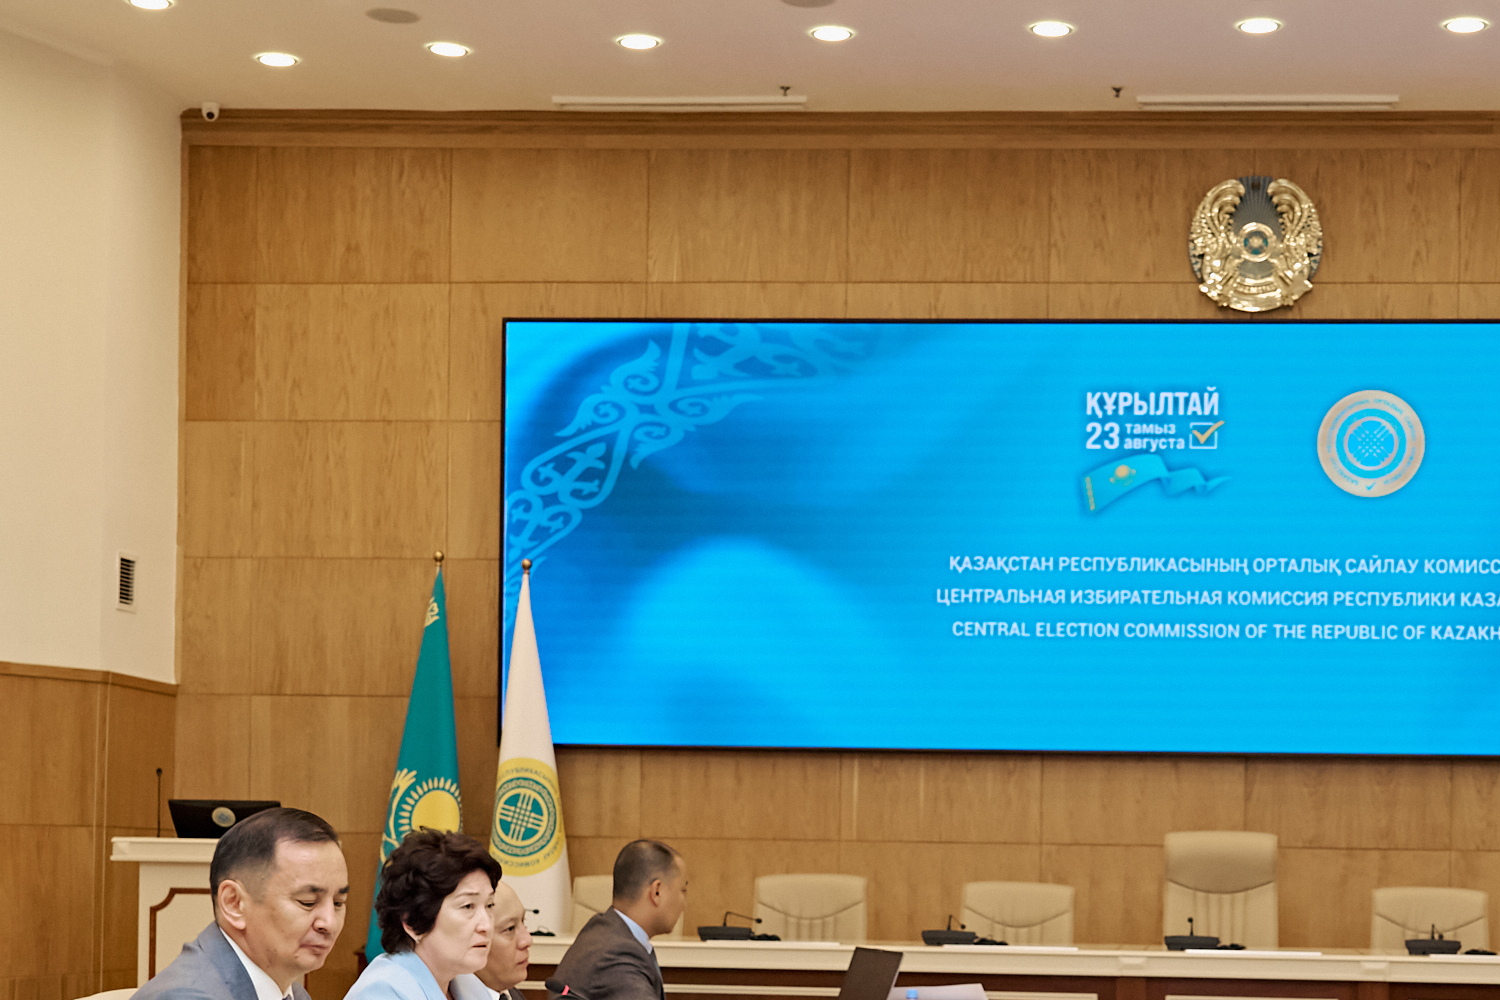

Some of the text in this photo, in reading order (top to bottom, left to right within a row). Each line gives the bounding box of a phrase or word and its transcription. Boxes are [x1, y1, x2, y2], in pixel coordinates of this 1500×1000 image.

[1086, 386, 1219, 419] ҚҰРЫЛТАЙ
[1085, 421, 1176, 450] 23 тамыз
[1123, 437, 1185, 453] августа
[949, 555, 1054, 574] ҚАЗАҚСТАН
[1058, 556, 1250, 576] РЕСПУБЛИКАСЫНЫҢ
[1252, 557, 1342, 576] ОРТАЛЫҚ
[1345, 554, 1419, 574] САЙЛАУ
[936, 588, 1066, 607] ЦЕНТРАЛЬНАЯ
[1070, 589, 1223, 605] ИЗБИРАТЕЛЬНАЯ
[1227, 590, 1328, 606] КОМИССИЯ
[1333, 591, 1456, 607] РЕСПУБЛИКИ
[952, 621, 1031, 637] CENTRAL
[1035, 621, 1120, 638] ELECTION
[1123, 622, 1240, 639] COMMISSION
[1245, 623, 1268, 639] OF
[1272, 623, 1307, 640] THE
[1311, 624, 1398, 640] REPUBLIC
[1403, 624, 1426, 640] OF
